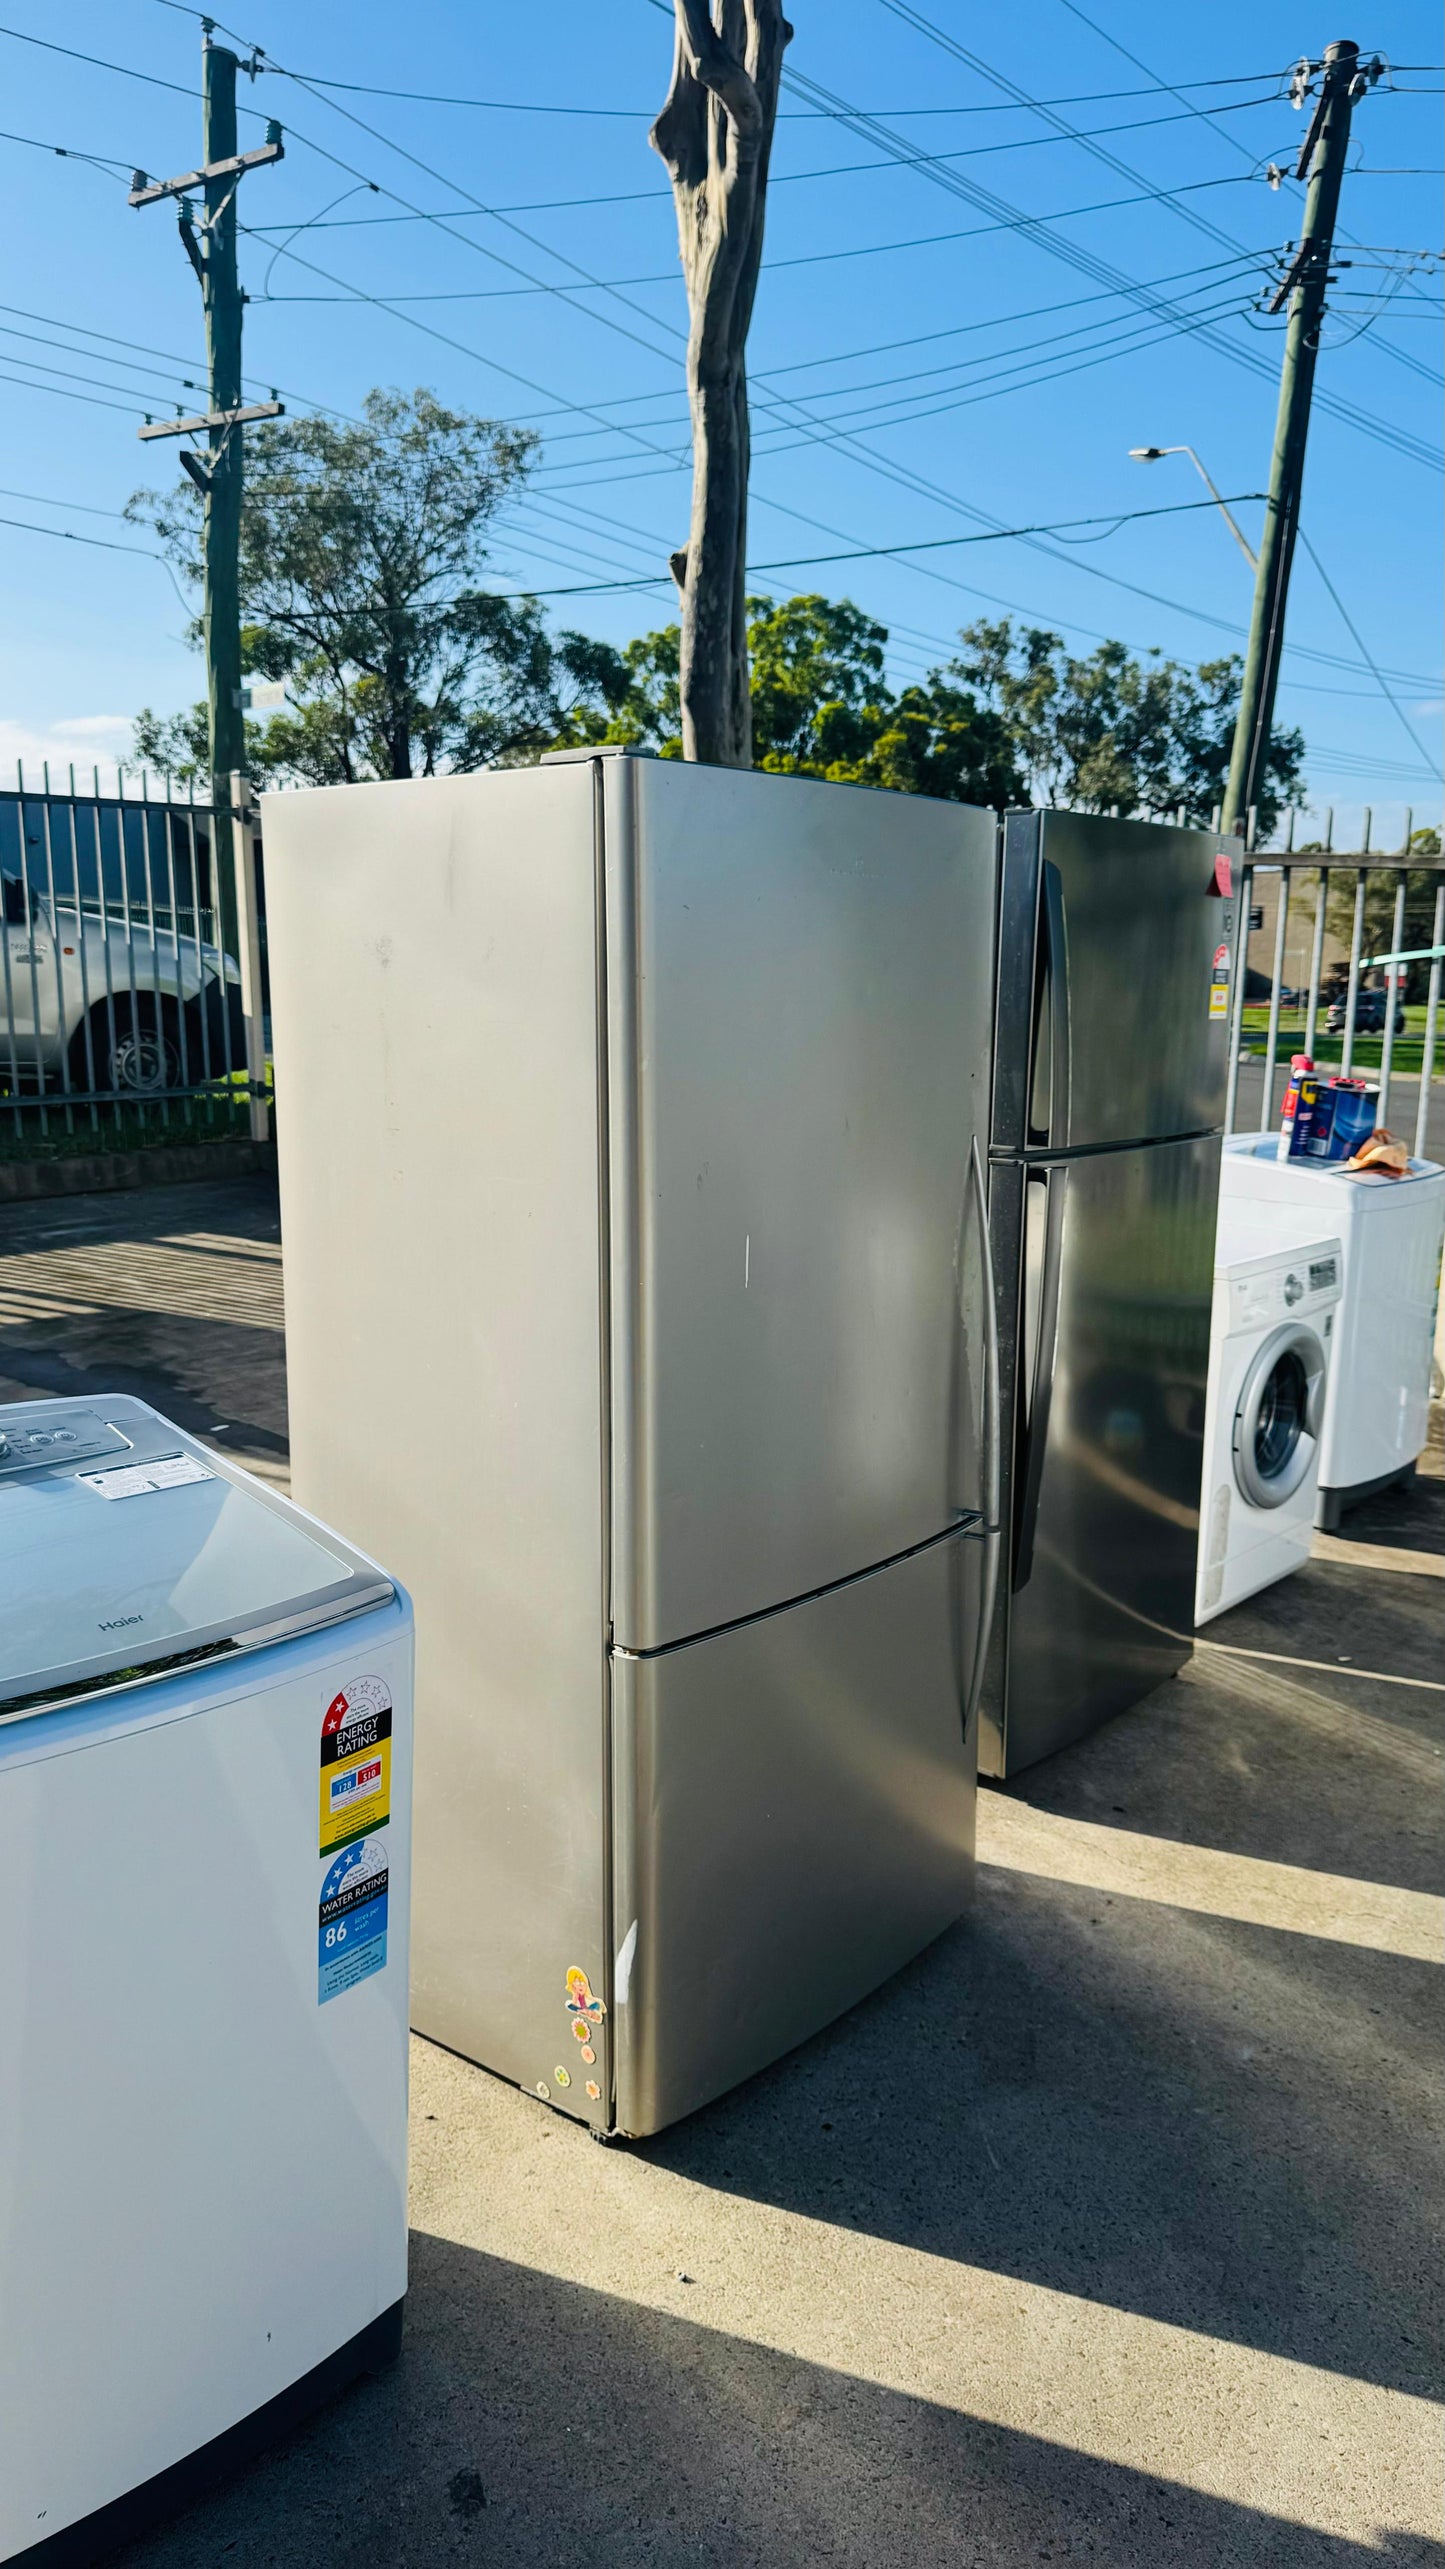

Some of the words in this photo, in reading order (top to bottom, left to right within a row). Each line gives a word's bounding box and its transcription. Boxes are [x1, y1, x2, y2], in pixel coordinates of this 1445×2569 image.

[98, 1614, 144, 1632] Haier
[336, 1716, 379, 1745] ENERGY
[337, 1729, 378, 1757] RATING
[339, 1780, 352, 1793] 128
[362, 1769, 376, 1782] 510
[322, 1892, 354, 1914] WATER
[355, 1872, 387, 1898] RATING
[325, 1920, 347, 1948] 86
